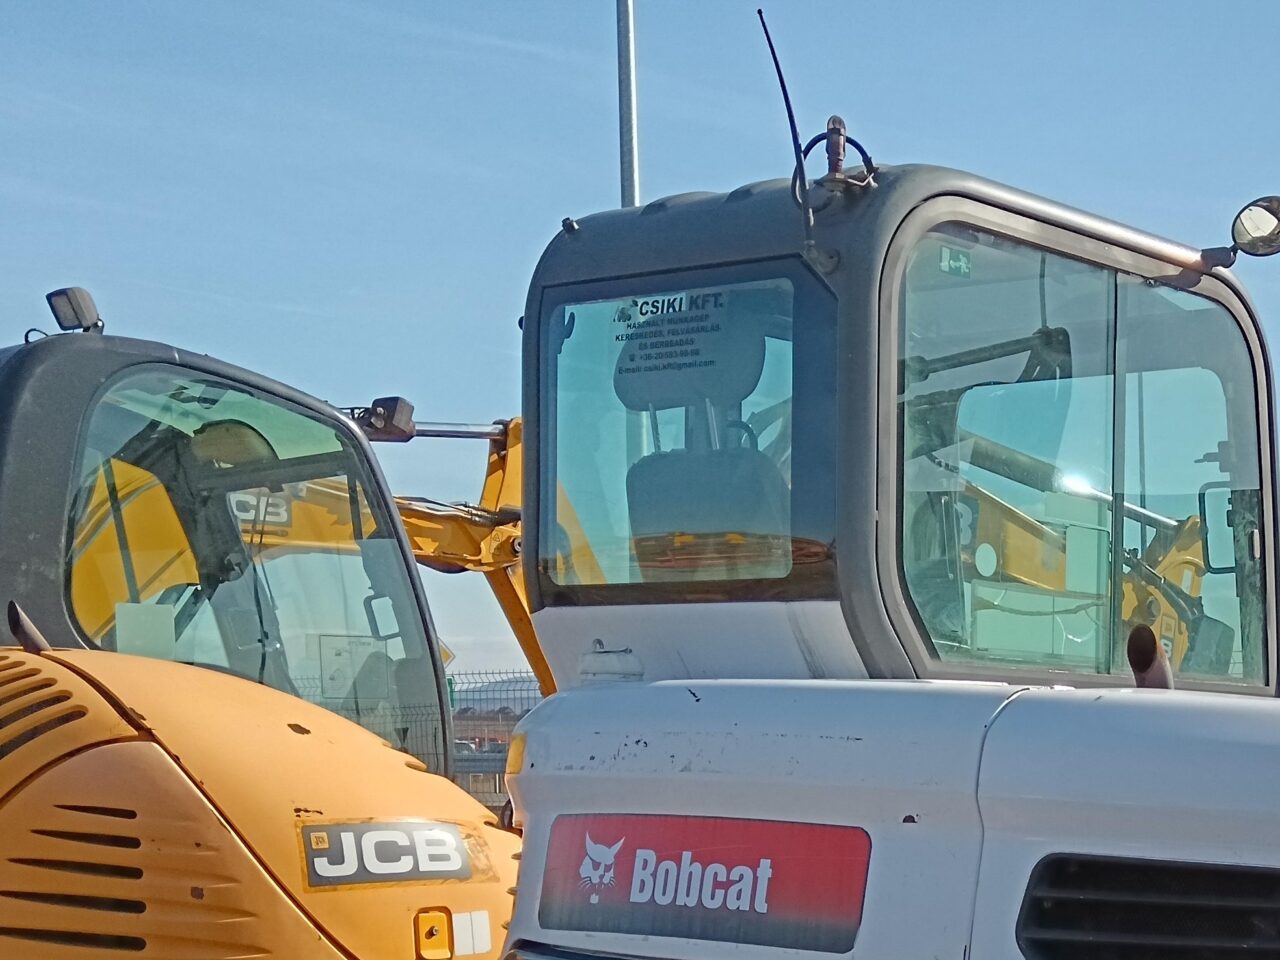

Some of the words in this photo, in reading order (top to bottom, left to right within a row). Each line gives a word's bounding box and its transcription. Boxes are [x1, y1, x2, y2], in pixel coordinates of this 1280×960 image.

[639, 297, 683, 316] CSIKI
[689, 292, 724, 311] KFT.
[230, 494, 287, 522] CB
[313, 830, 463, 877] JCB
[629, 849, 773, 914] Bobcat
